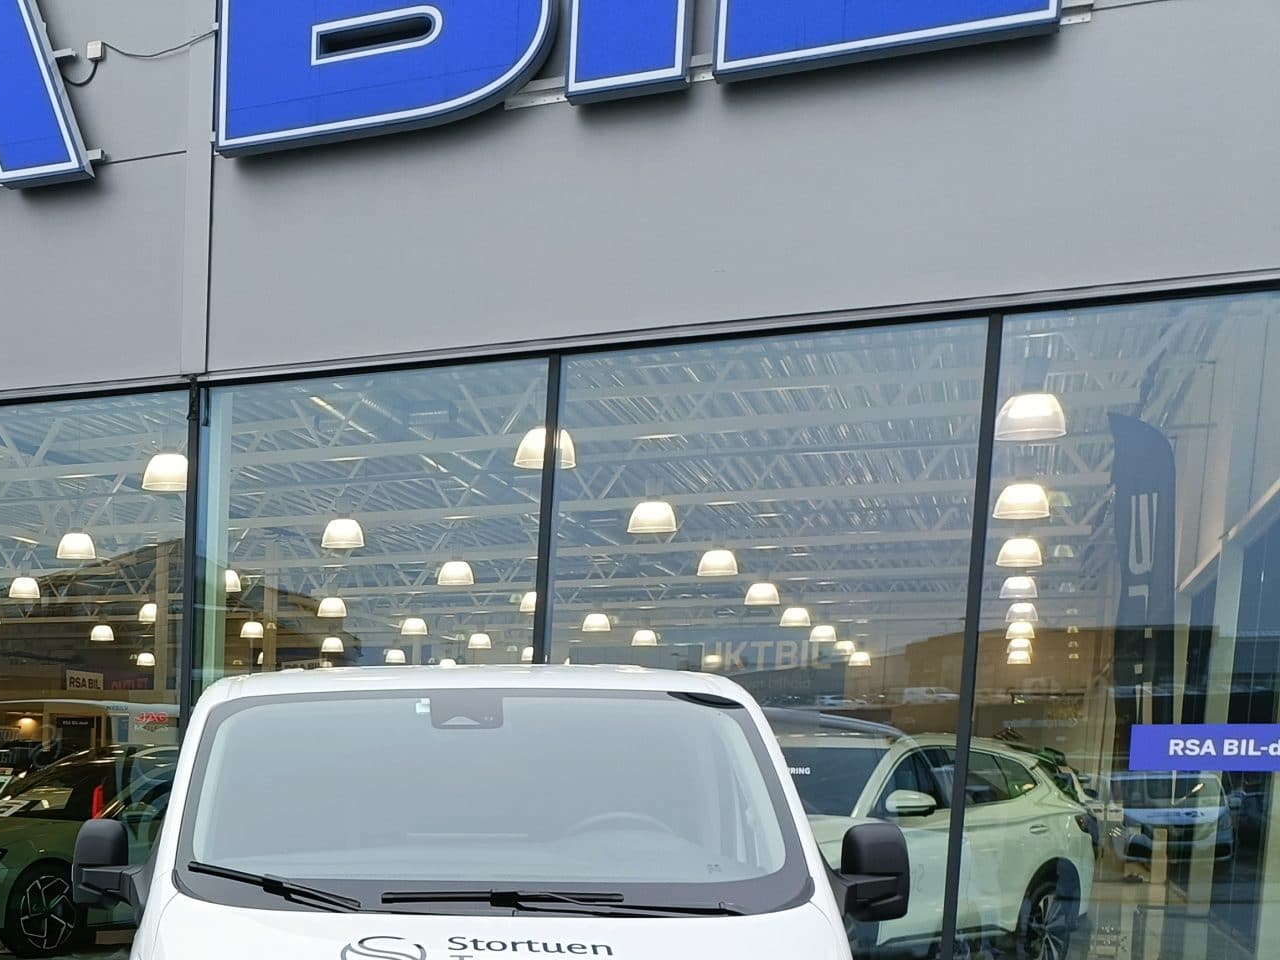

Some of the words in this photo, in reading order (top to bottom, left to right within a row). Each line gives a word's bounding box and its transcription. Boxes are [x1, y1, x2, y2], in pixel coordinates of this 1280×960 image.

[69, 677, 86, 688] RSA
[88, 679, 101, 689] BIL
[1169, 739, 1216, 756] RSA
[789, 767, 811, 775] RING
[447, 936, 614, 956] Stortuen
